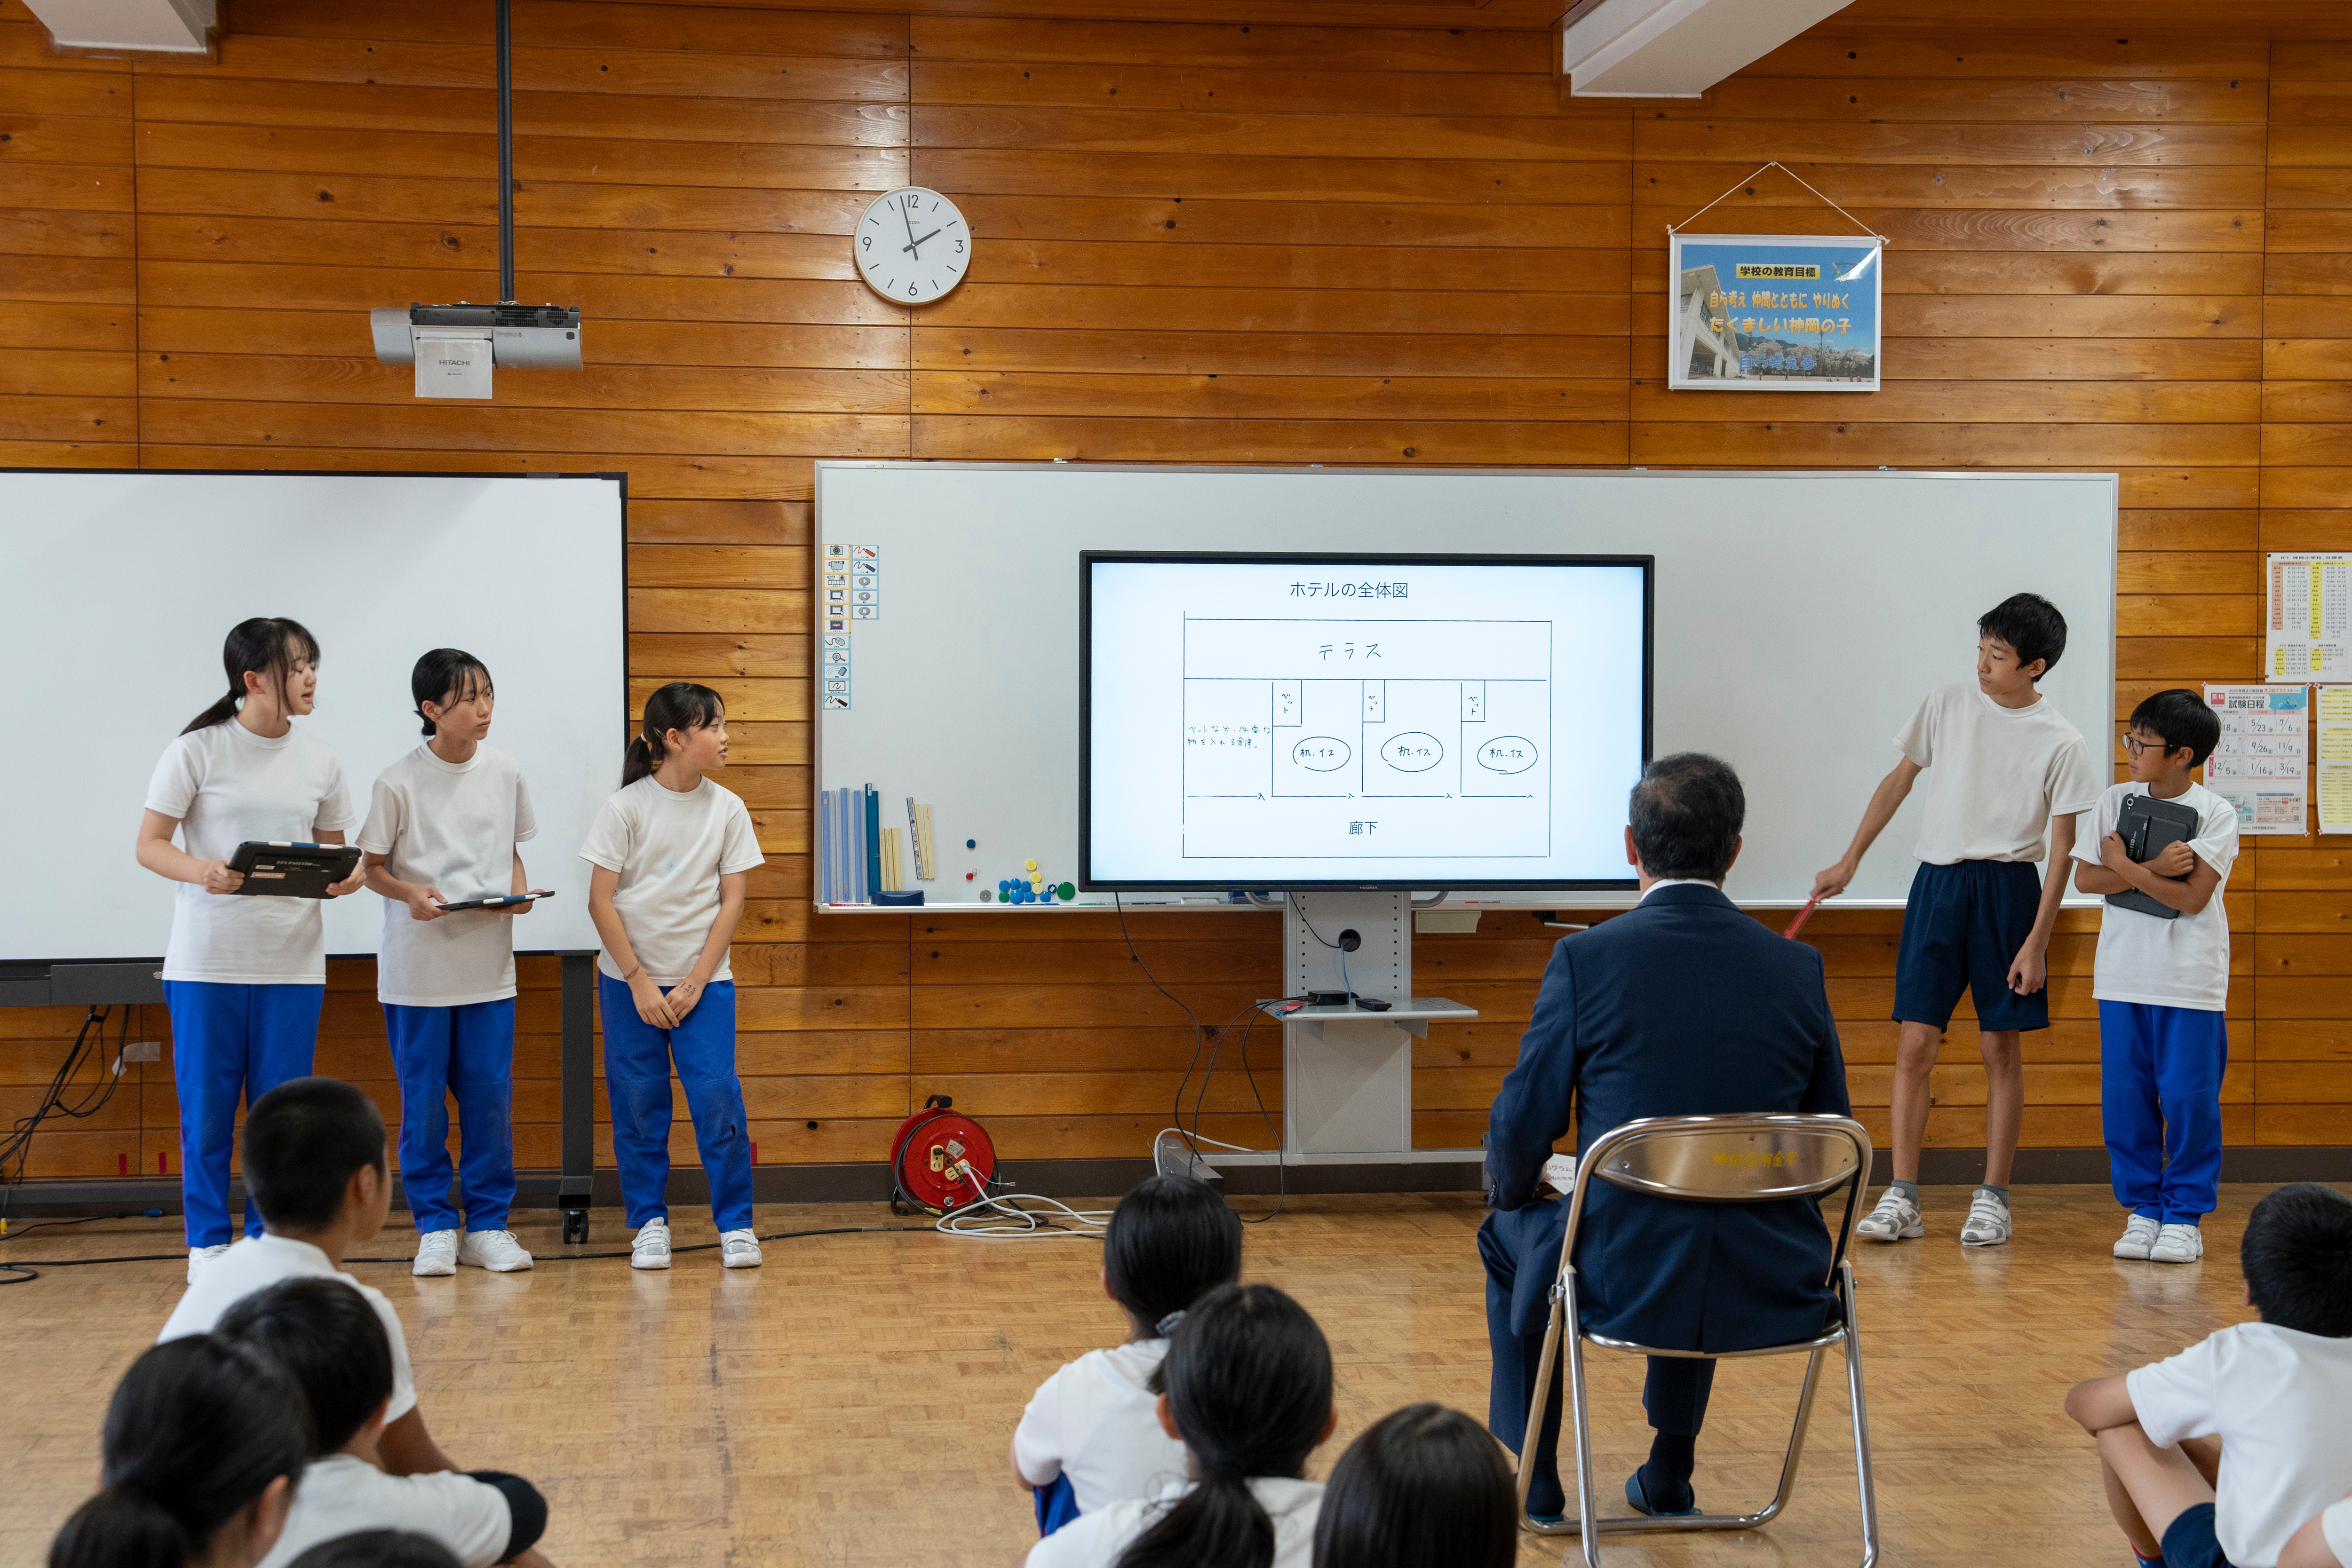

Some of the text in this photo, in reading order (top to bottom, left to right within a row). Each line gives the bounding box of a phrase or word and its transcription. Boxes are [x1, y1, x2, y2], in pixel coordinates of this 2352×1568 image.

[908, 194, 918, 208] 12
[863, 237, 872, 251] 9
[955, 240, 963, 253] 3
[1740, 267, 1816, 277] 学校の教育目標
[909, 281, 917, 296] 6
[1710, 290, 1849, 309] 自ら考え 仲間とともに やりぬく
[1709, 317, 1851, 334] たくましい神岡の子
[1740, 355, 1814, 371] 自ら考える
[1290, 582, 1408, 599] ホテルの全体図
[1319, 642, 1381, 661] テラス
[1281, 694, 1293, 713] ベット
[1368, 696, 1378, 712] ベット
[1469, 697, 1479, 715] ベット
[2229, 700, 2265, 709] 試験日程
[1187, 737, 1257, 749] 物を入れる倉庫。
[1300, 748, 1334, 758] 机、イス
[1398, 745, 1431, 756] 机、イス
[1490, 748, 1523, 758] 机、イス
[1349, 821, 1378, 835] 廊下
